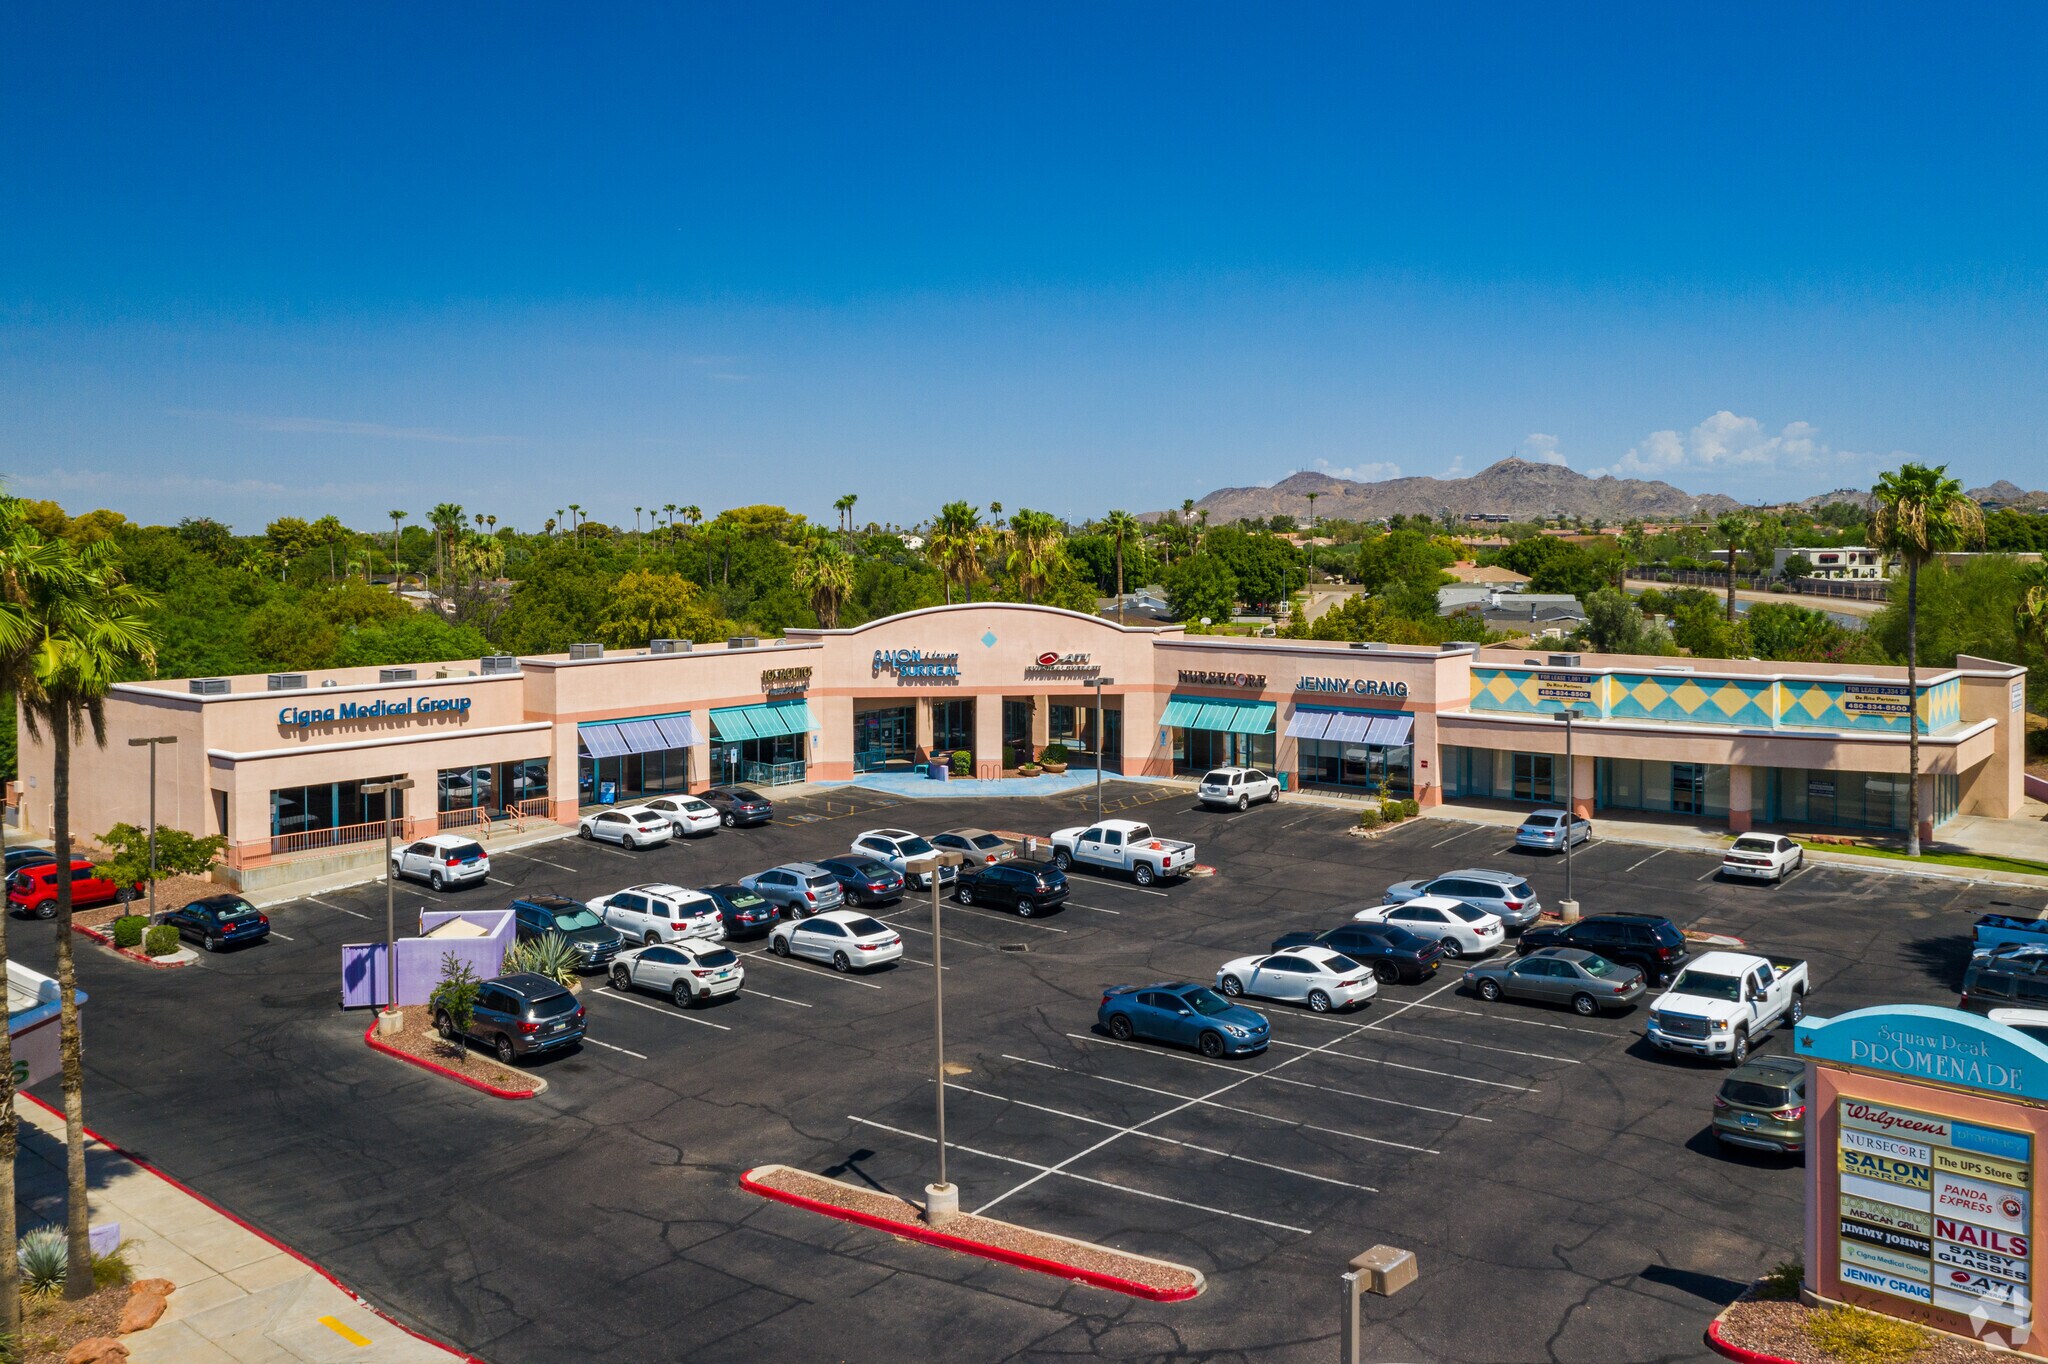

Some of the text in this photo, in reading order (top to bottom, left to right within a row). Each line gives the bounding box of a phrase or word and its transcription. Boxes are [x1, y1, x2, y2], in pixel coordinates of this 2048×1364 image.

[873, 649, 921, 669] SALON
[900, 663, 962, 677] SURREAL
[1062, 653, 1092, 663] ATI
[1177, 669, 1267, 689] NURSECORE
[1296, 675, 1408, 698] JENNY CRAIG
[1540, 689, 1589, 698] 480-834-8500
[278, 696, 472, 728] Cigna Medical Group
[1848, 702, 1908, 712] 480-834-8500
[1877, 1024, 1991, 1058] Squaw Peak
[1850, 1038, 2024, 1092] PROMENADE
[1846, 1103, 1948, 1136] Walgreens
[1846, 1133, 1927, 1160] NURSECORE
[1844, 1151, 1930, 1182] SALON
[1845, 1165, 1929, 1189] SURREAL
[1938, 1155, 1958, 1168] The
[1960, 1160, 1982, 1173] UPS
[1984, 1165, 2013, 1180] Store
[1939, 1194, 1993, 1214] EXPRESS
[1944, 1184, 1988, 1201] PANDA
[1841, 1196, 1930, 1226] LOS TAQUITOS
[1849, 1208, 1922, 1233] MEXICAN GRILL
[1841, 1222, 1930, 1252] JIMMY JOHN'S
[1936, 1219, 2028, 1257] NAILS
[1856, 1250, 1929, 1275] Cigna Medical Group
[1938, 1252, 2027, 1281] GLASSES
[1949, 1245, 2016, 1267] SASSY
[1843, 1268, 1931, 1299] JENNY CRAIG
[1950, 1281, 1980, 1294] PHYSICAL
[1970, 1277, 2015, 1296] ATI
